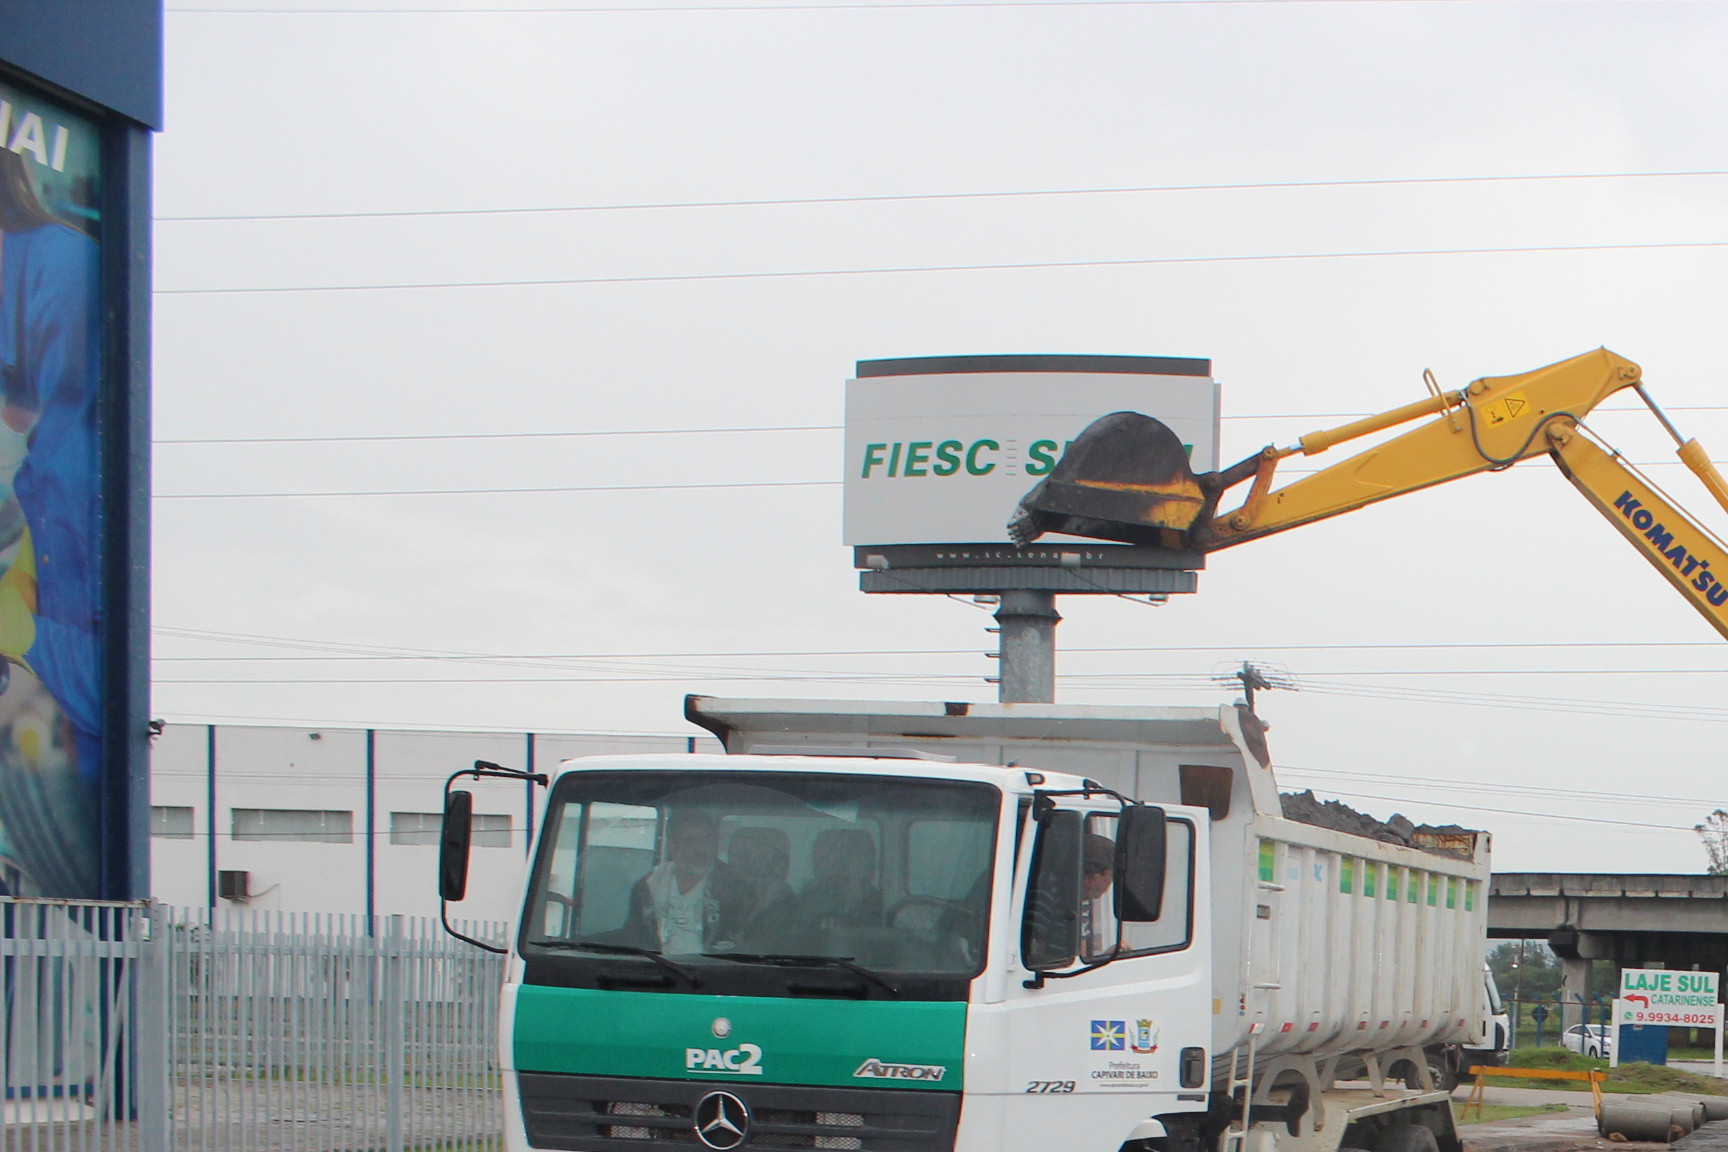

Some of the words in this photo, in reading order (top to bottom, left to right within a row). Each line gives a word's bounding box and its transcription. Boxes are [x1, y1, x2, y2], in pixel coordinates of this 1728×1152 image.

[861, 439, 999, 479] FIESC
[1625, 973, 1671, 991] LAJE
[1678, 975, 1714, 993] SUL
[1651, 994, 1715, 1006] CATARINENSE
[1636, 1012, 1715, 1024] 9.9934-8025
[686, 1043, 763, 1074] PAC2
[1109, 1061, 1140, 1070] Prefeitura
[1091, 1070, 1125, 1079] CAPIVARI
[1126, 1070, 1135, 1079] DE
[1136, 1070, 1159, 1079] BAIXO
[1025, 1081, 1076, 1094] 2729
